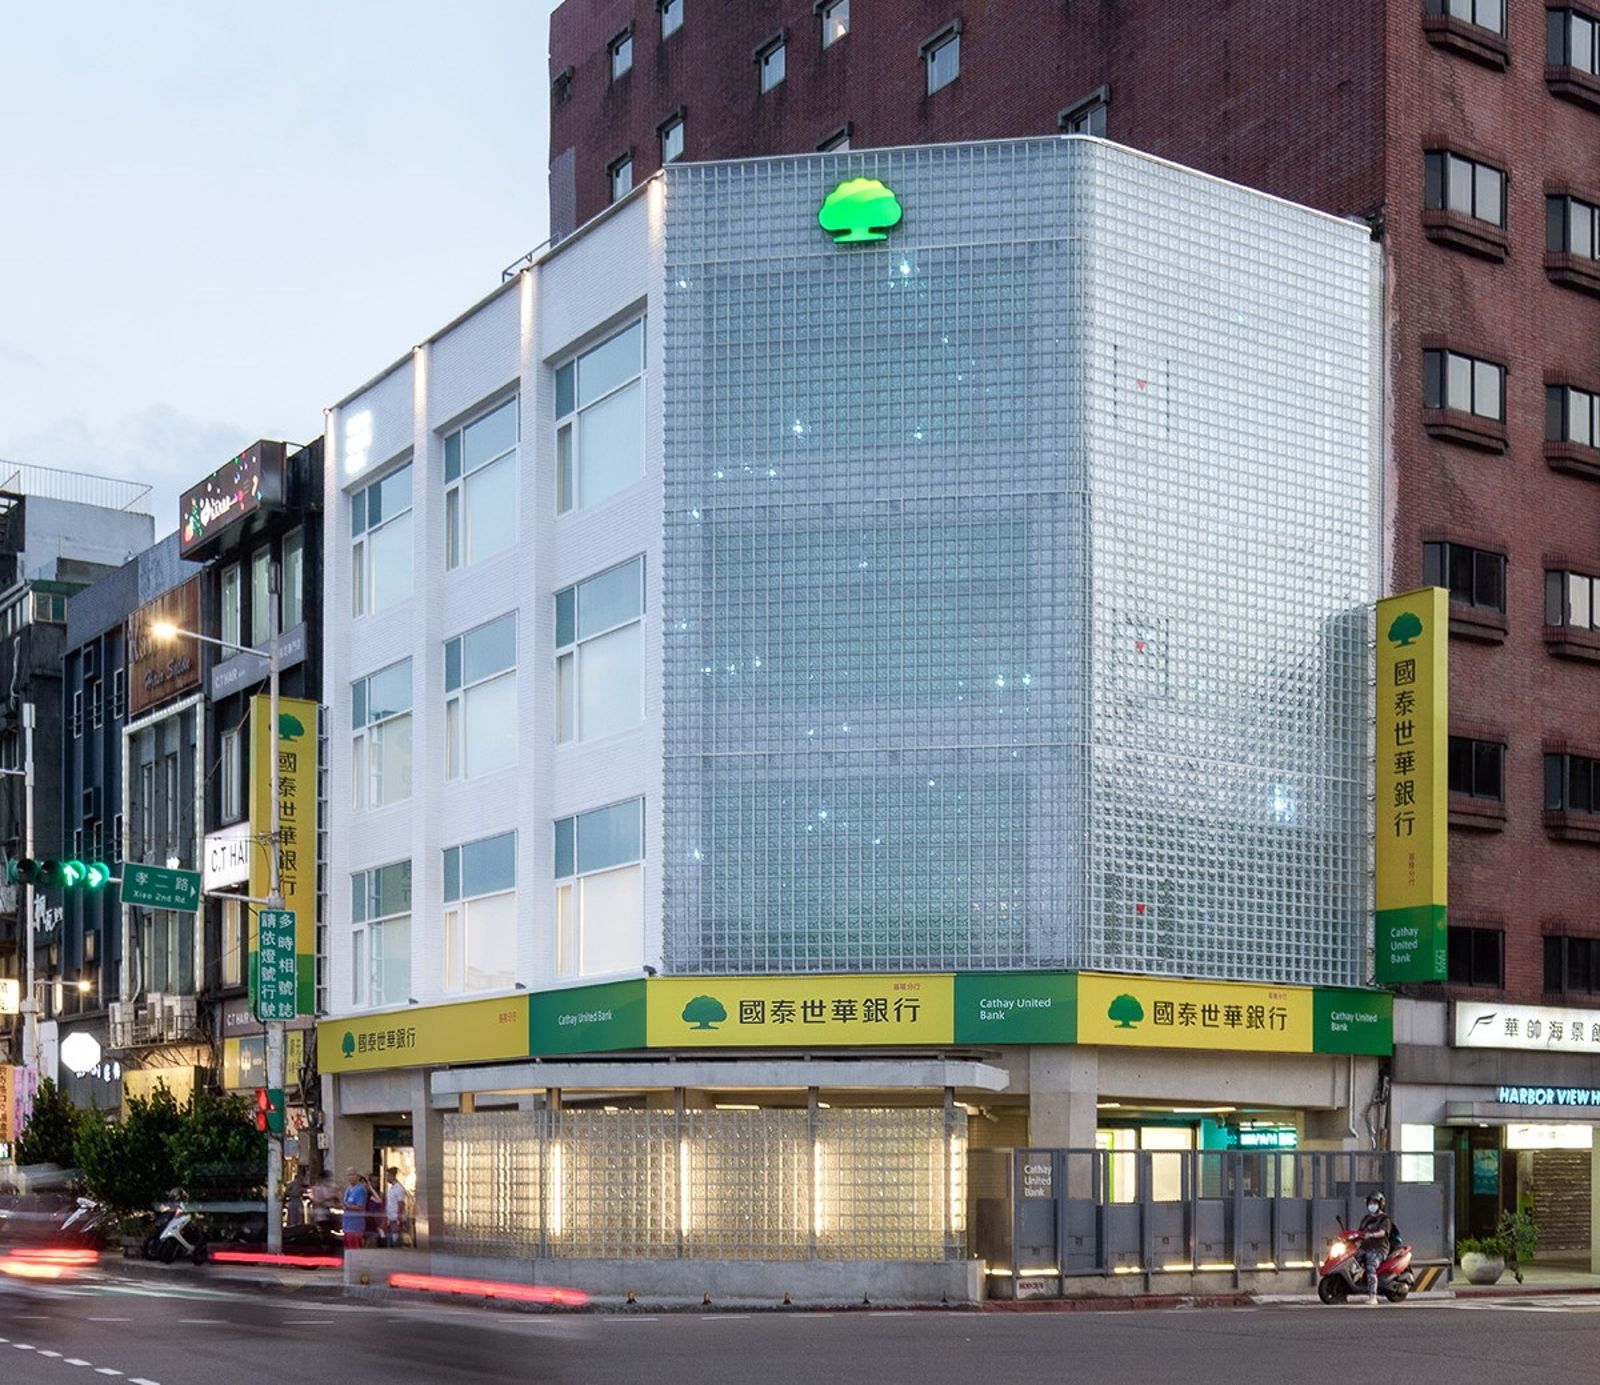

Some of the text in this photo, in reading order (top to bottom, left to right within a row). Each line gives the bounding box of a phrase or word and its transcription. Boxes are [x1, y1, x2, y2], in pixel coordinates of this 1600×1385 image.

[1394, 658, 1416, 838] 國泰世華銀行
[135, 871, 189, 892] 孝二路
[133, 890, 152, 899] Xiao
[155, 892, 171, 902] 2nd
[1390, 927, 1419, 938] Cathay
[1390, 940, 1418, 952] United
[1390, 953, 1411, 964] Bank
[261, 913, 277, 1018] 請依燈號行駛
[278, 915, 294, 1018] 多時相號誌
[979, 997, 1052, 1010] Cathay United
[739, 997, 921, 1025] 國泰世華銀行
[979, 1010, 1006, 1021] Bank
[1153, 1000, 1288, 1031] 國泰世華銀行
[1331, 1011, 1378, 1023] Cathay United
[558, 1010, 613, 1026] Cathay United Bank
[1331, 1022, 1348, 1032] Bank
[358, 1027, 416, 1053] 國泰世華銀行
[1499, 1087, 1554, 1105] HARBOR
[1557, 1088, 1590, 1105] VIEW
[1024, 1164, 1052, 1176] Cathay
[1024, 1176, 1052, 1186] United
[1024, 1187, 1045, 1197] Bank
